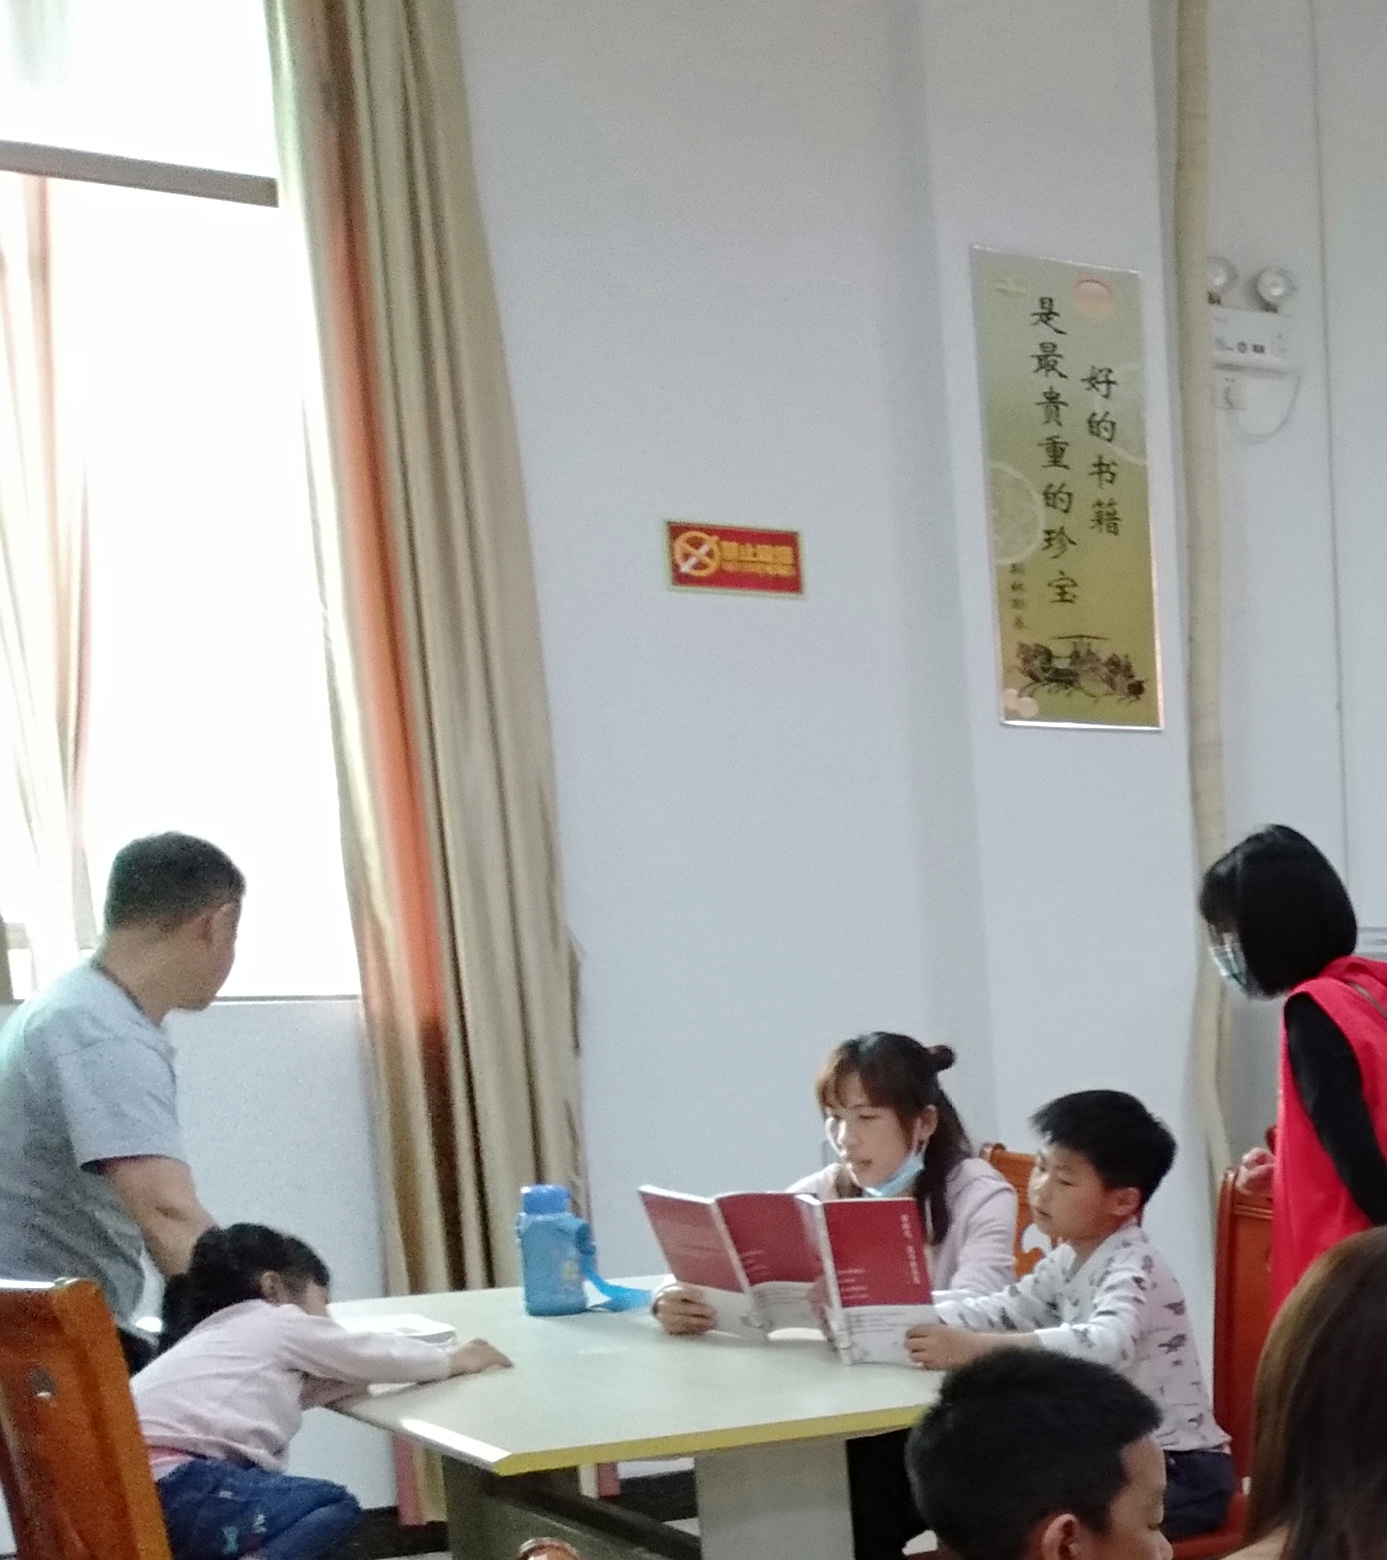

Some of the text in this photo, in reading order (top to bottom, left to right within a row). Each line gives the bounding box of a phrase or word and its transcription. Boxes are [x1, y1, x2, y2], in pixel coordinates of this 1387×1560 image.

[1030, 295, 1078, 605] 是最贵重的珍宝
[1081, 365, 1121, 536] 好的书籍
